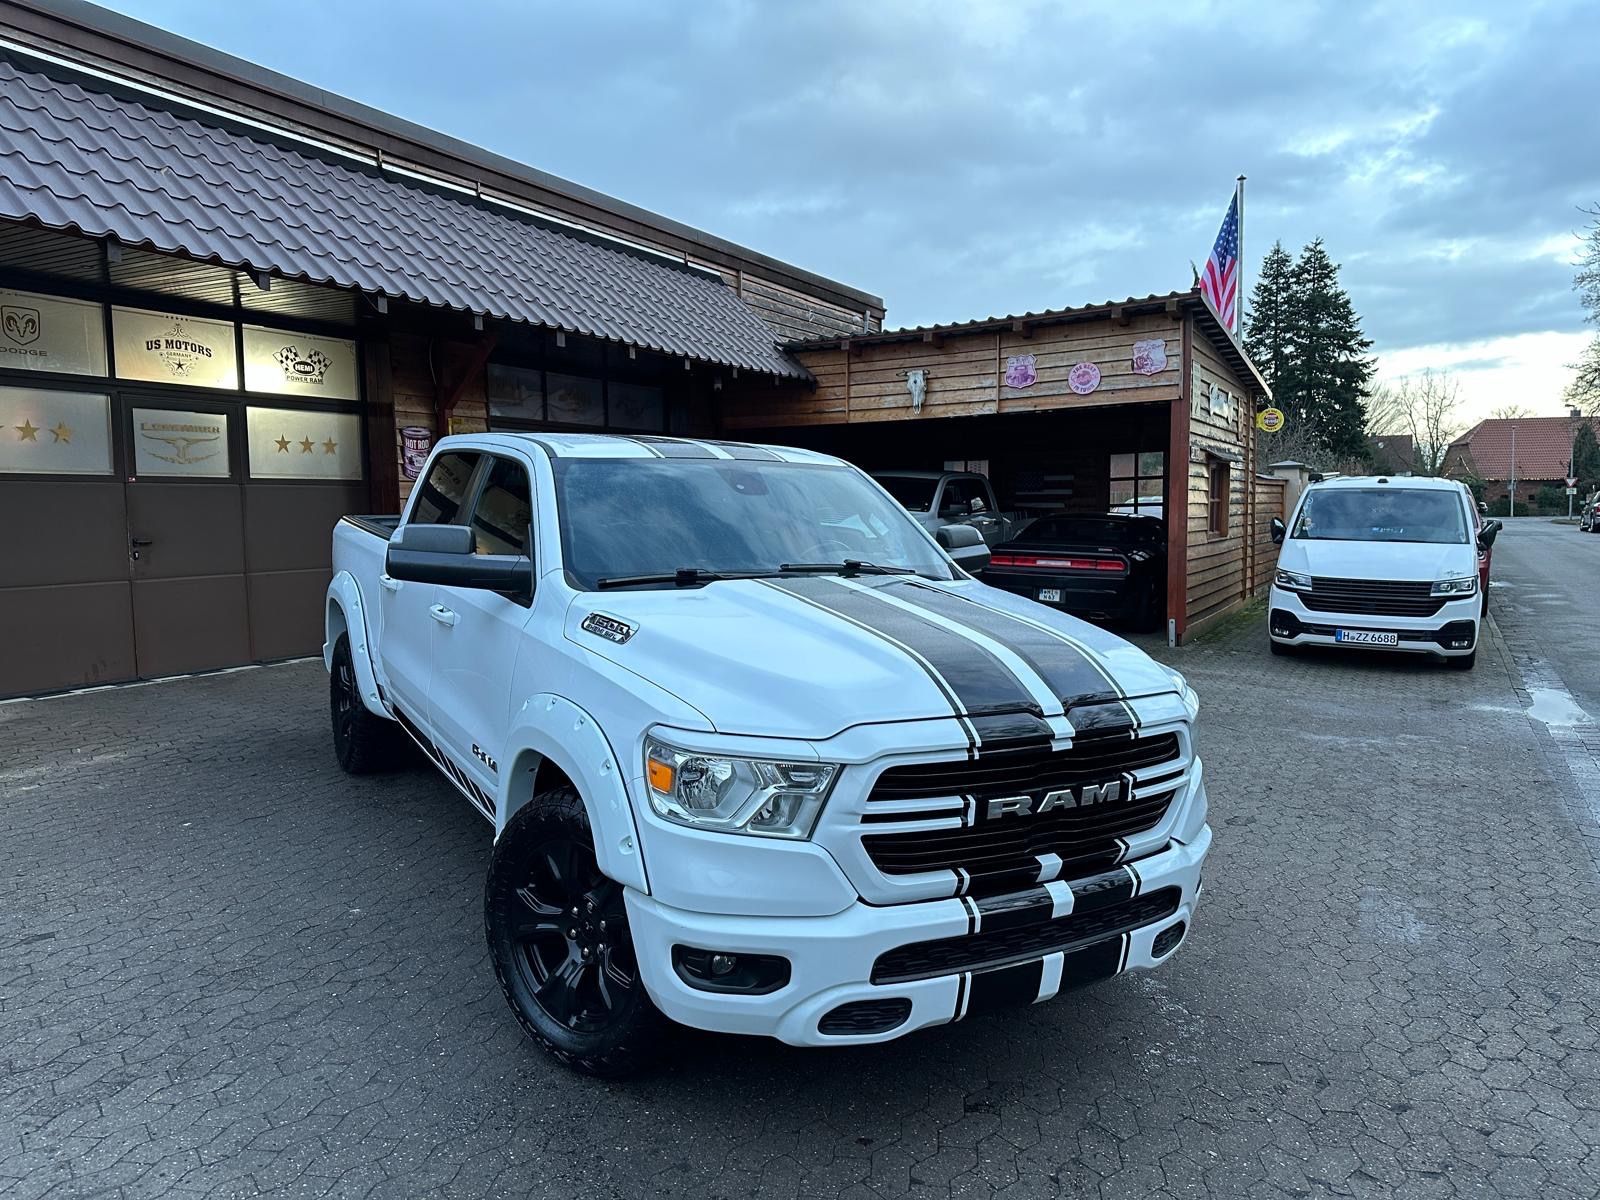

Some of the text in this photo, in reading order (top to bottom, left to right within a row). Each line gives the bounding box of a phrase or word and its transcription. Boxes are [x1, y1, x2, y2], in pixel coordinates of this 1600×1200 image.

[0, 346, 47, 356] DODGE
[146, 339, 212, 358] US MOTORS
[294, 363, 313, 372] HEMI
[405, 438, 429, 450] HOT ROD
[1343, 632, 1396, 643] H ZZ 6688
[987, 781, 1120, 819] RAM
